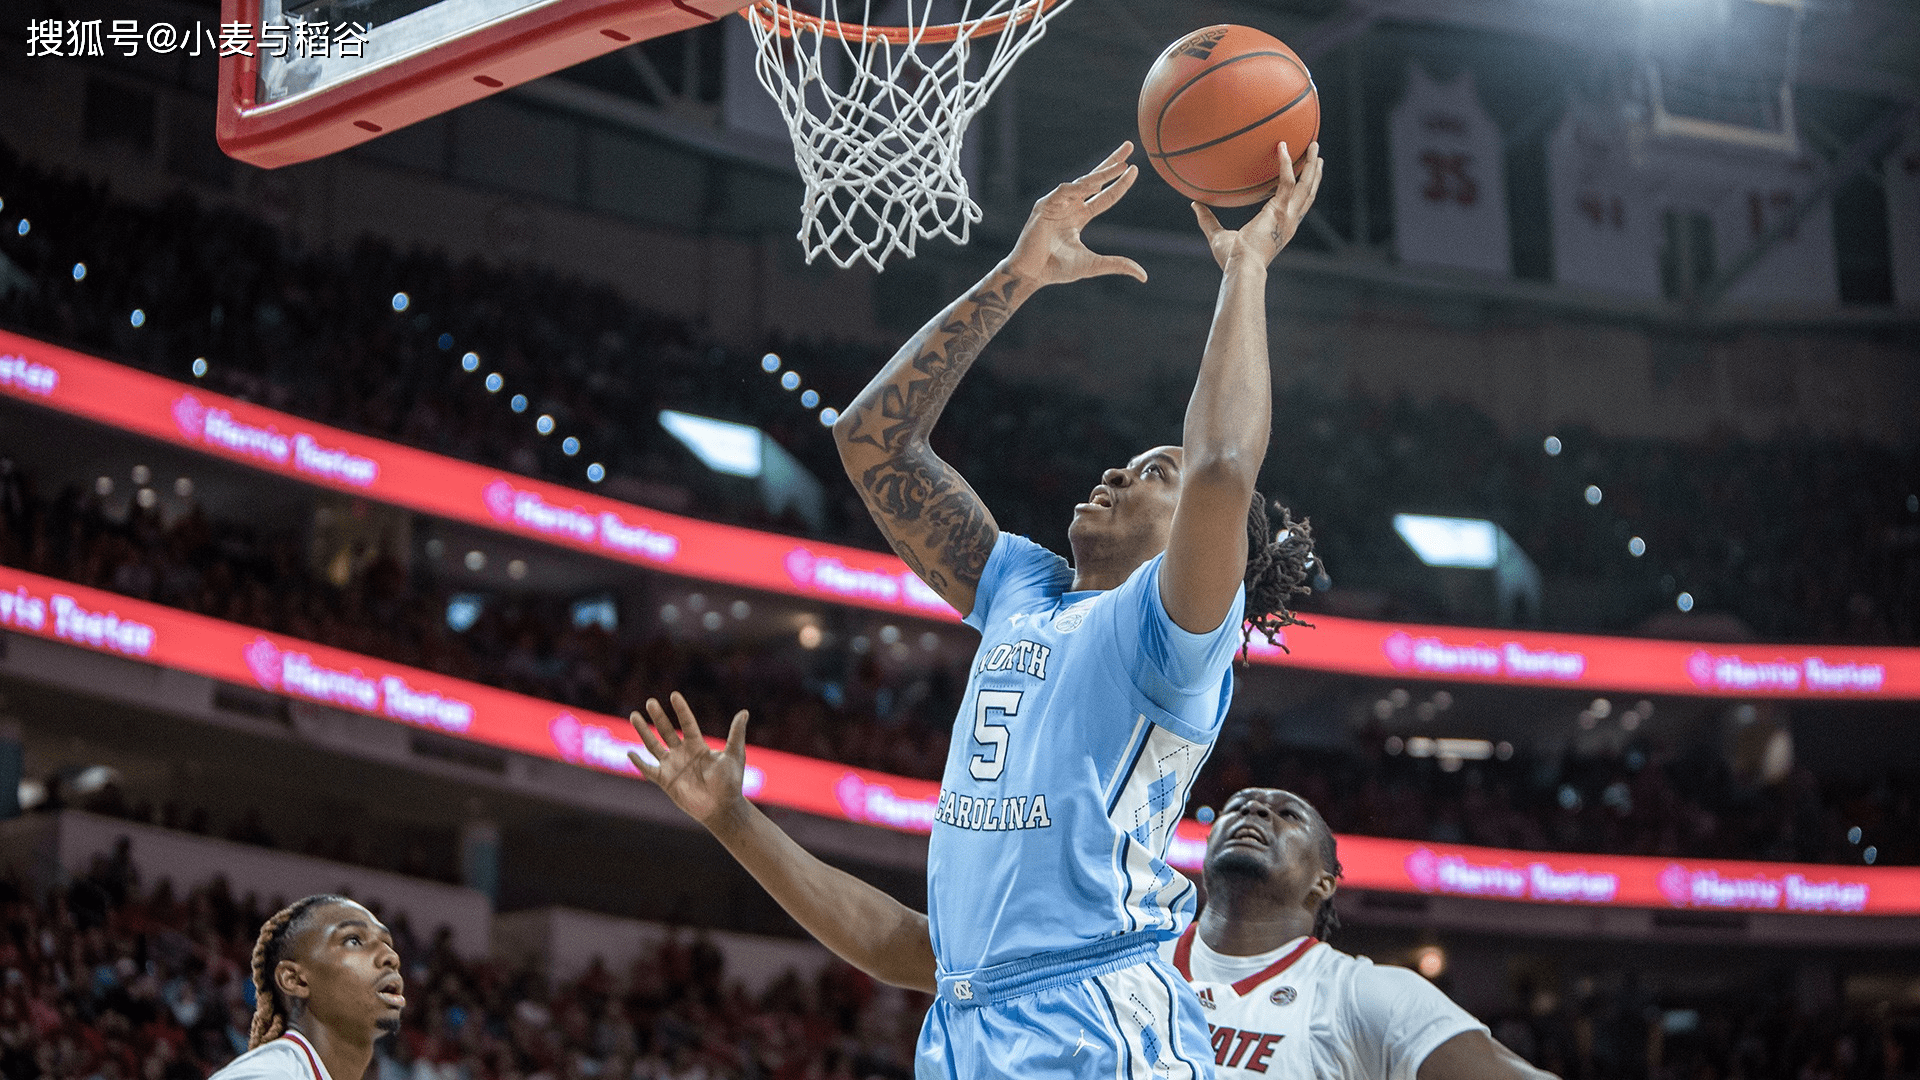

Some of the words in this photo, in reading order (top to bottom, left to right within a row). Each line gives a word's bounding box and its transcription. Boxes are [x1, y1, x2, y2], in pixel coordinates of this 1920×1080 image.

[974, 639, 1052, 681] NORTH
[969, 689, 1024, 782] 5
[935, 788, 1052, 831] CAROLINA
[1208, 1023, 1285, 1074] ATE
